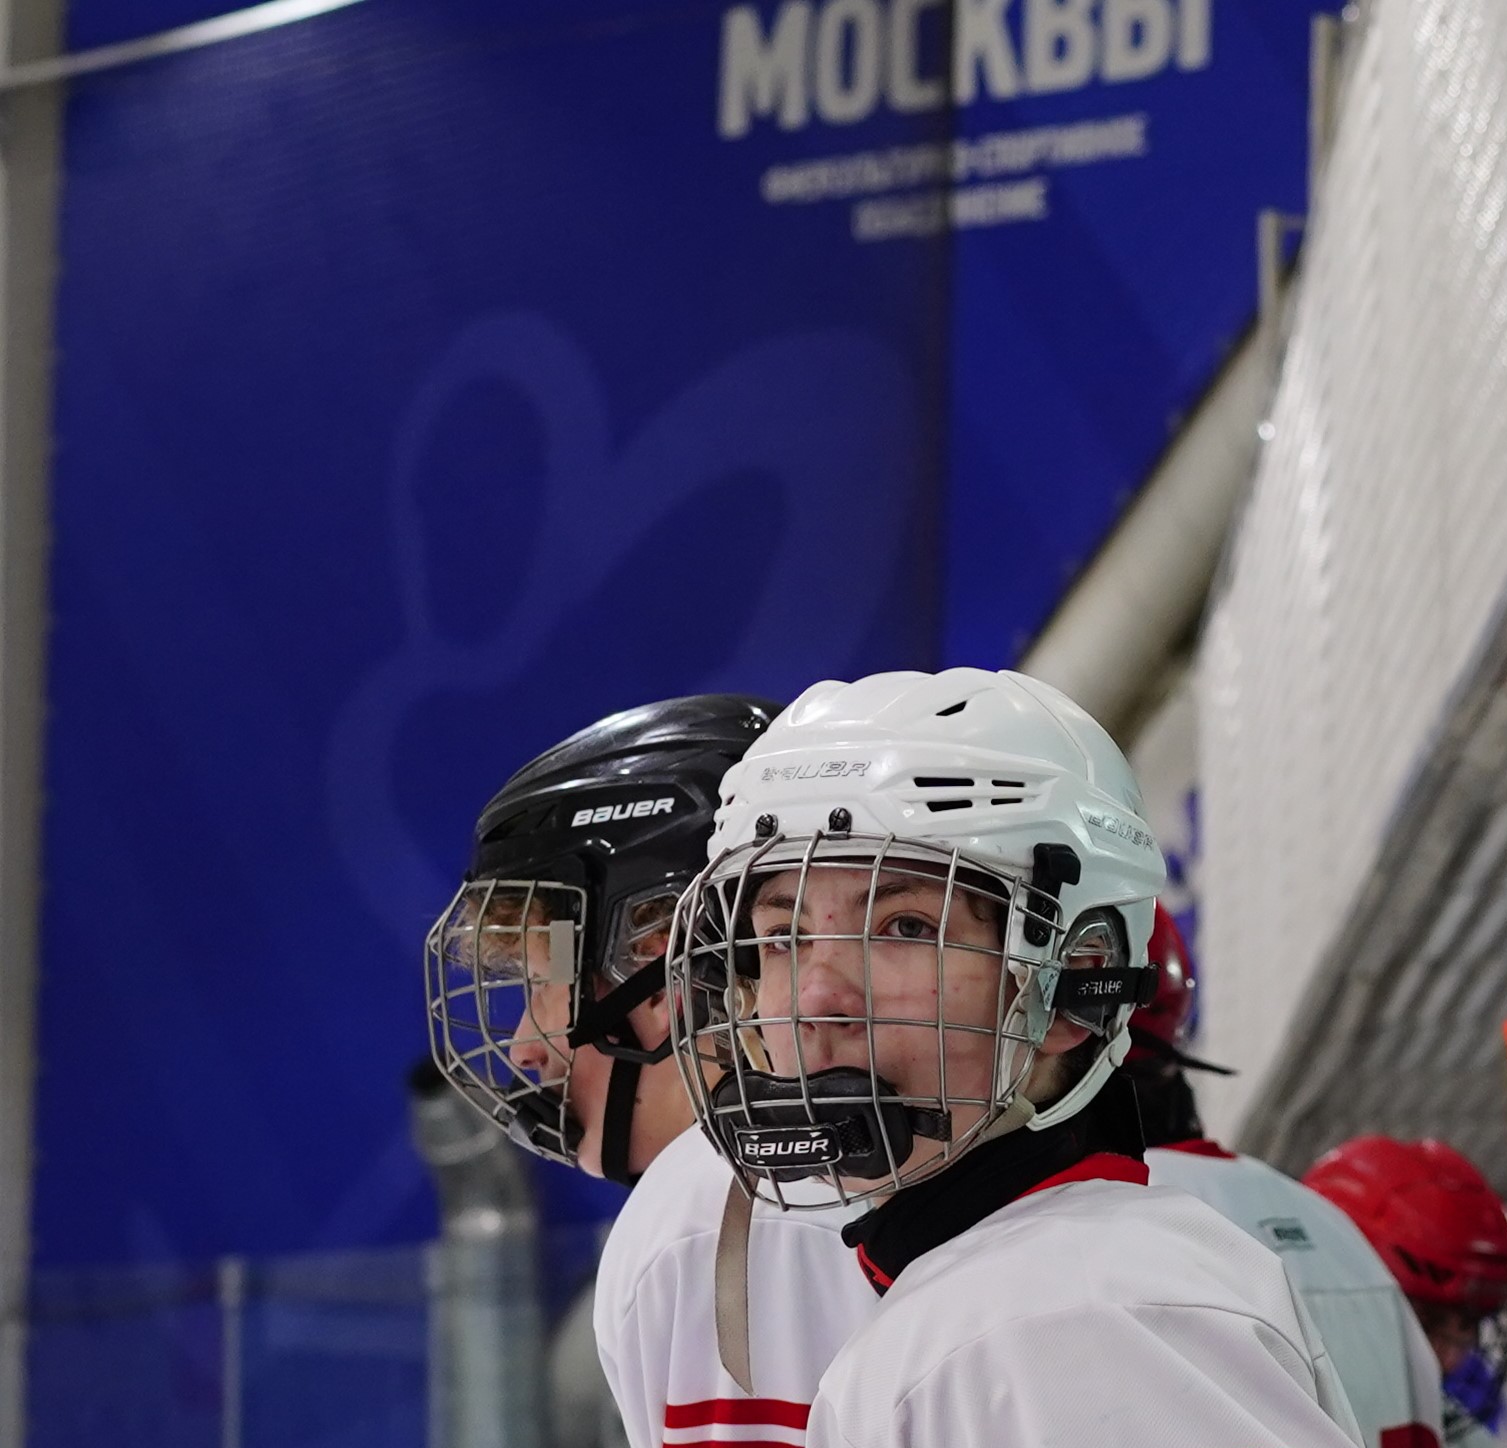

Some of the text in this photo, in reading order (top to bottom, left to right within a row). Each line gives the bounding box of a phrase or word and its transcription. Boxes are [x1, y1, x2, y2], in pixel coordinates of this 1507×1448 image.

[716, 0, 1214, 140] МОСКВЫ
[571, 797, 675, 827] BAUER
[744, 1138, 830, 1157] BAUER
